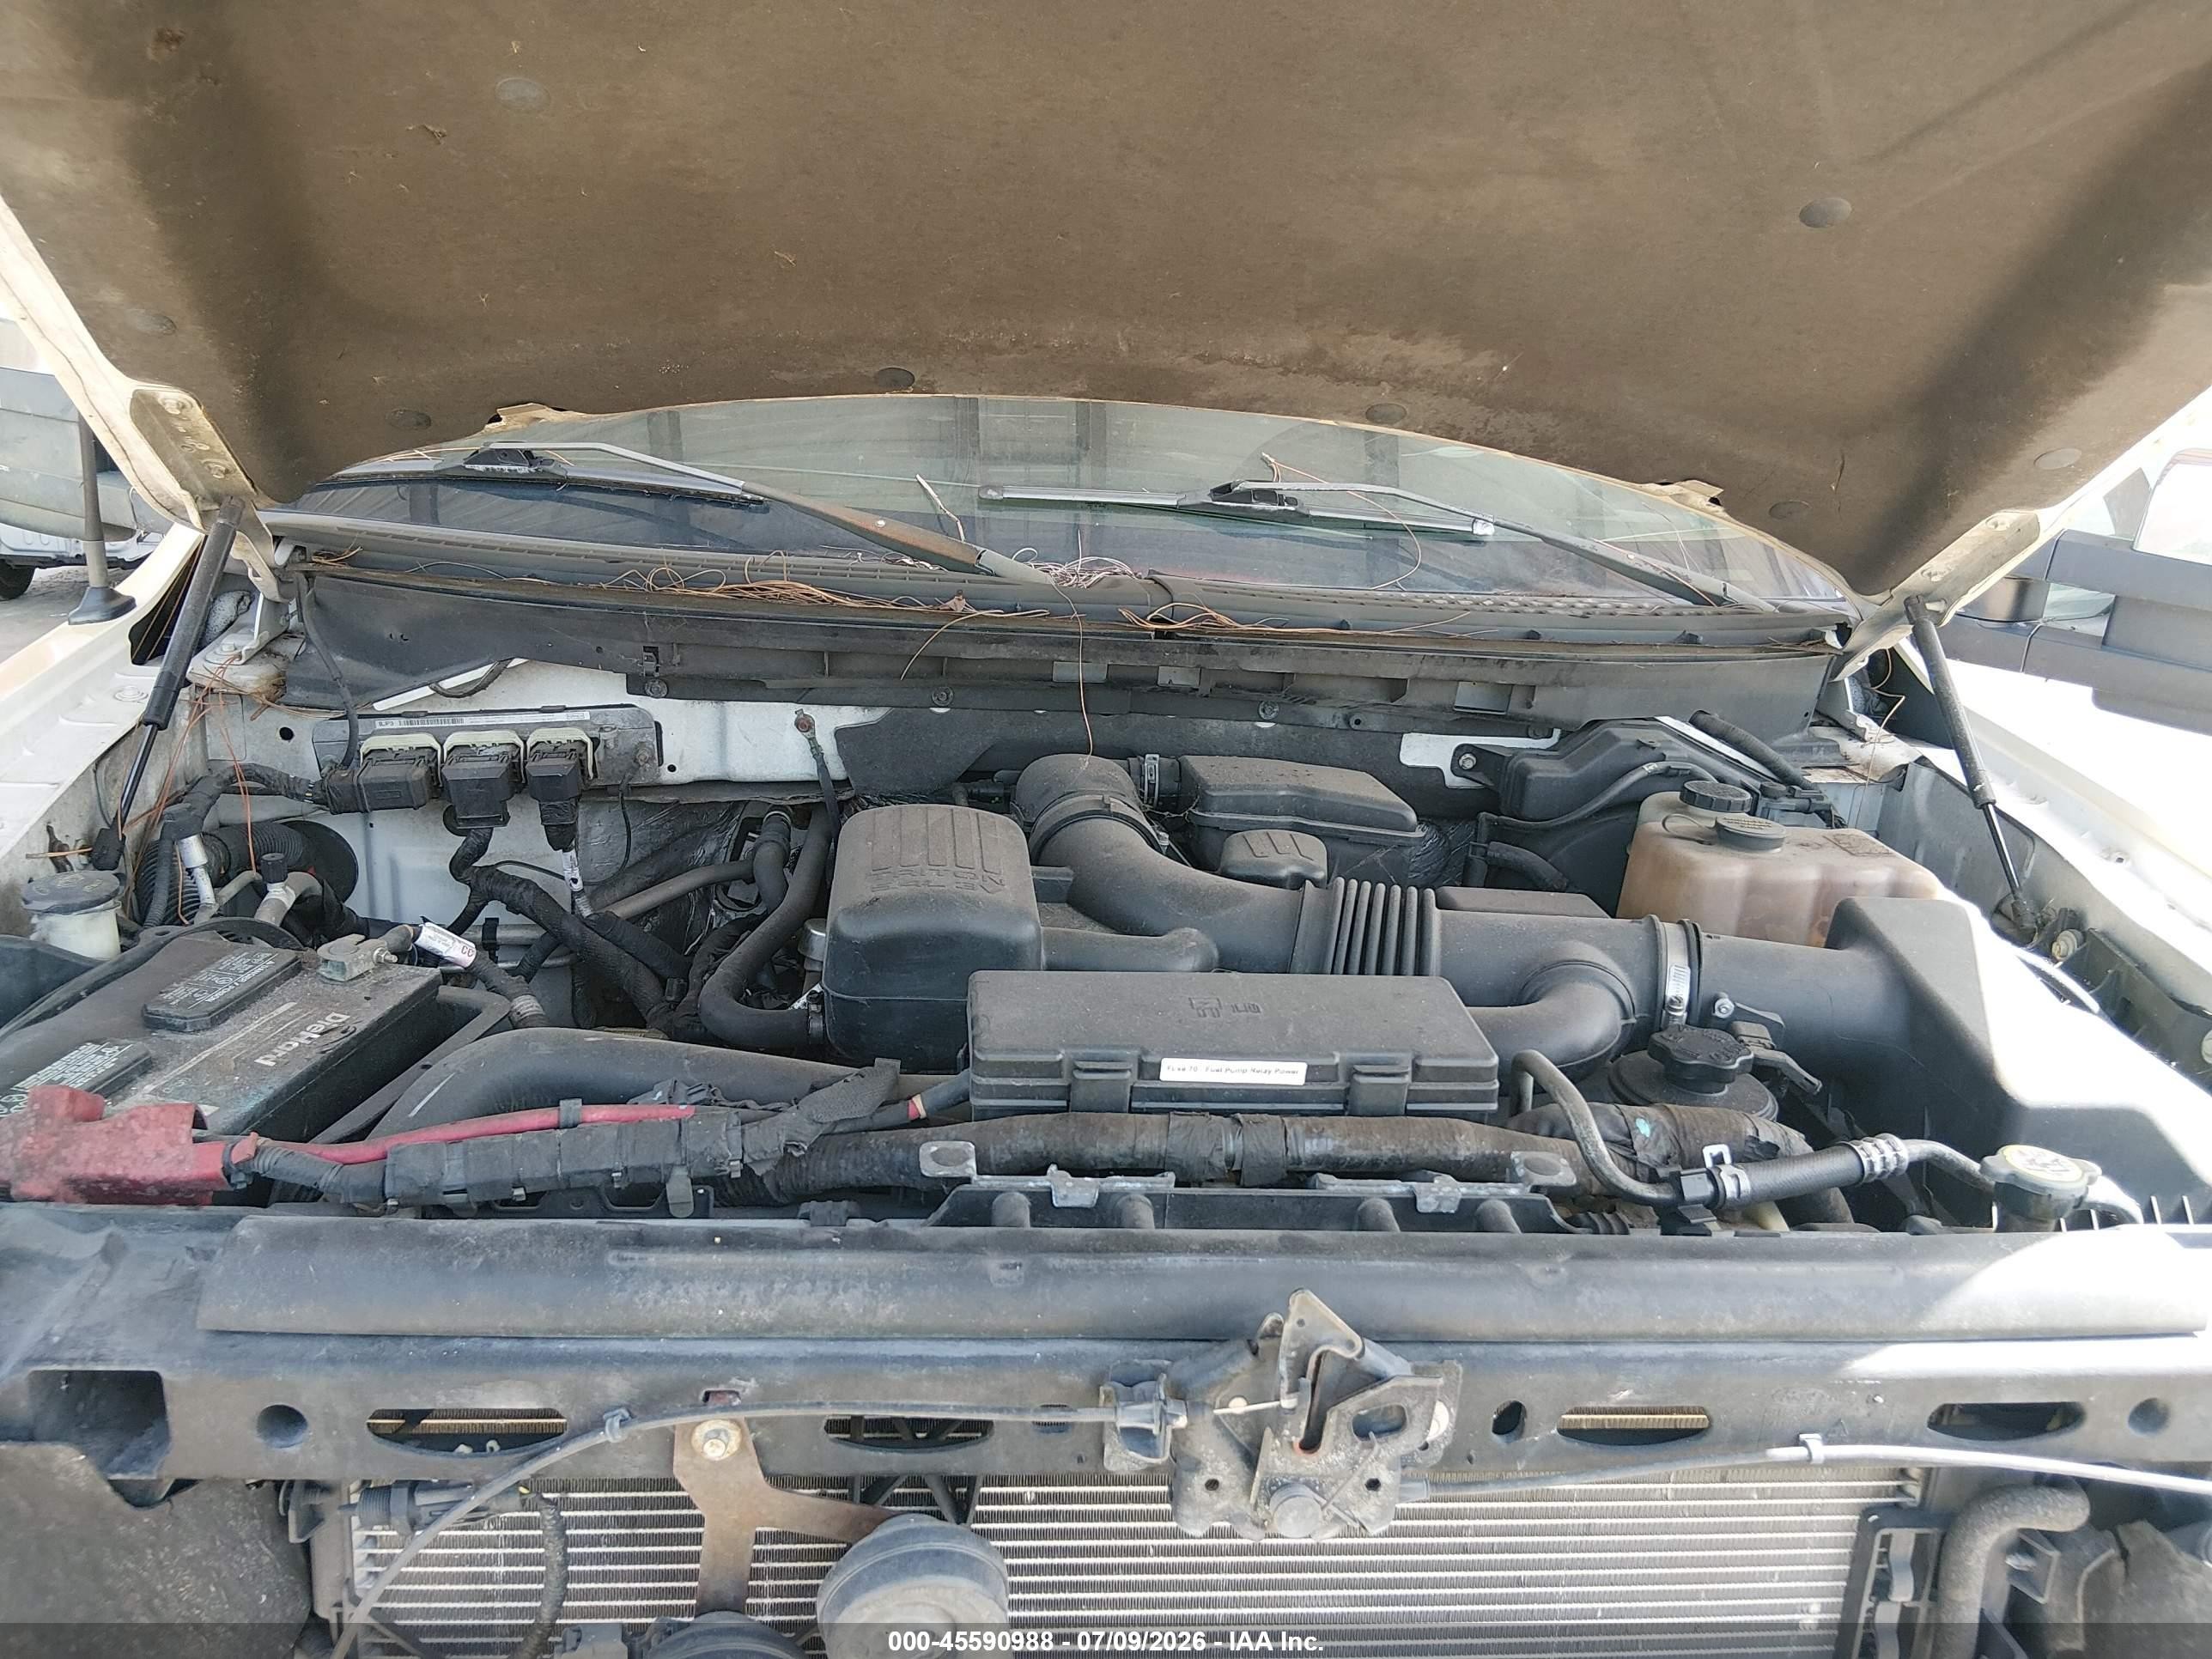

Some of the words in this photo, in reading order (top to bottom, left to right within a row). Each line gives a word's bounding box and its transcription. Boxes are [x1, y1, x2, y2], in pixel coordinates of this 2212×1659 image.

[253, 1012, 351, 1066] DieHard
[1205, 1065, 1224, 1073] Fuel
[1224, 1065, 1249, 1075] Pump
[1250, 1066, 1273, 1076] Relay
